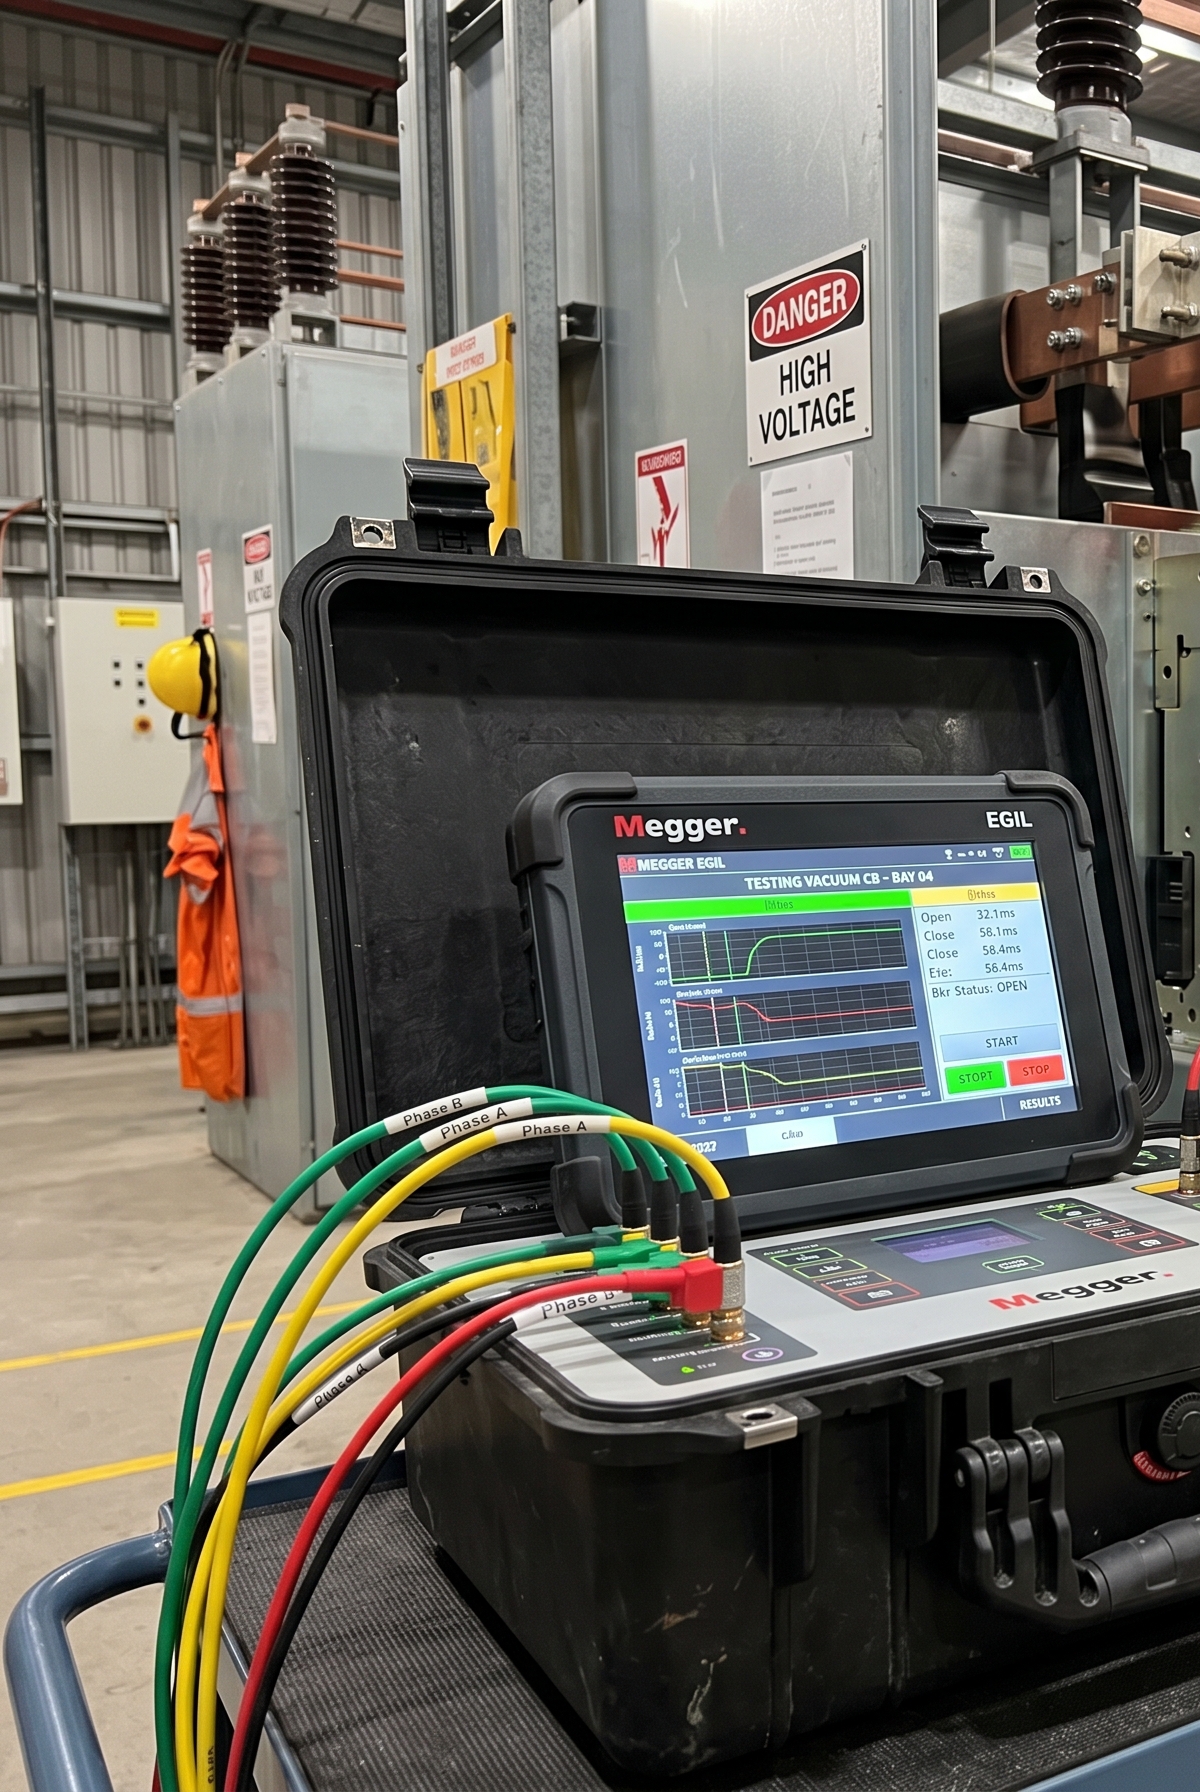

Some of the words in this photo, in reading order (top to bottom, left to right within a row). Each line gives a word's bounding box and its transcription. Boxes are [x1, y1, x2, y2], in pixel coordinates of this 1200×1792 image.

[763, 278, 847, 339] DANGER
[780, 349, 831, 396] HIGH
[759, 387, 856, 444] VOLTAGE
[986, 811, 1033, 830] EGIL
[637, 858, 694, 871] MEGGER
[696, 857, 726, 869] EGIL
[744, 875, 802, 890] TESTING
[803, 872, 861, 888] VACUUM
[863, 873, 880, 885] CB
[892, 871, 916, 883] BAY
[917, 870, 934, 882] 04
[921, 912, 952, 925] Open
[976, 909, 1016, 920] 32.1ms
[924, 931, 955, 942] Close
[979, 927, 1018, 938] 58.1ms
[927, 949, 959, 960] Close
[982, 944, 1022, 956] 58.4ms
[932, 987, 951, 998] Bkr
[954, 984, 994, 997] Status:
[997, 980, 1028, 993] OPEN
[985, 1036, 1019, 1049] START
[1022, 1064, 1050, 1077] STOP
[403, 1104, 448, 1127] Phase
[452, 1097, 463, 1110] B
[1019, 1095, 1062, 1111] RESULTS
[440, 1113, 491, 1140] Phase
[496, 1106, 509, 1120] A
[522, 1122, 571, 1137] Phase
[576, 1121, 588, 1133] A
[541, 1293, 598, 1319] Phase
